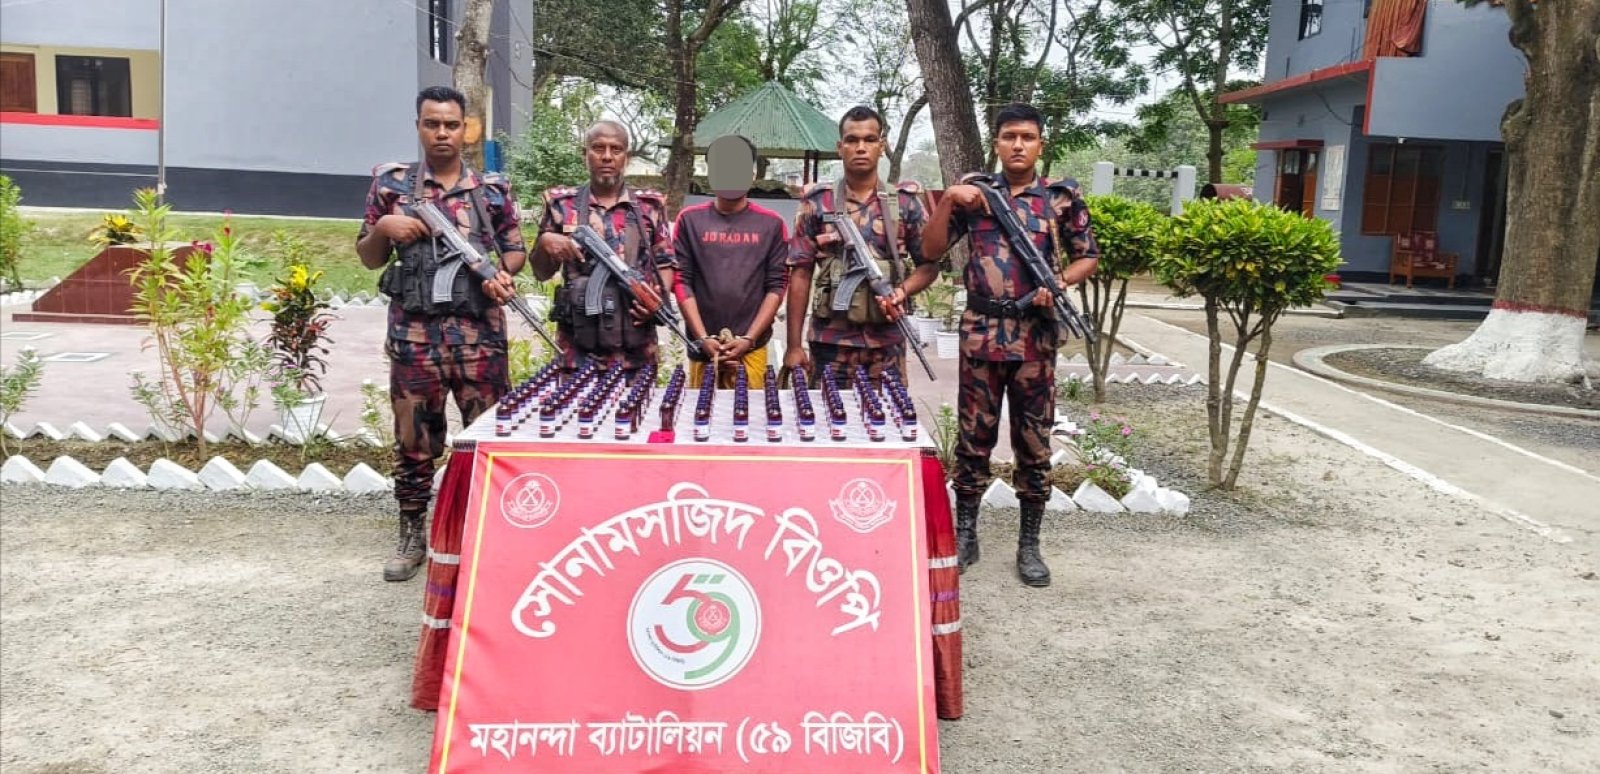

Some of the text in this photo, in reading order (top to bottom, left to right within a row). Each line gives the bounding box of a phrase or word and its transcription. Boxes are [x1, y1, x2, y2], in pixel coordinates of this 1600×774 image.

[511, 481, 881, 638] সোনামসজিদ বিওপি
[468, 710, 904, 764] মহানন্দা ব্যাটালিয়ন (৫৯ বিজিবি)
